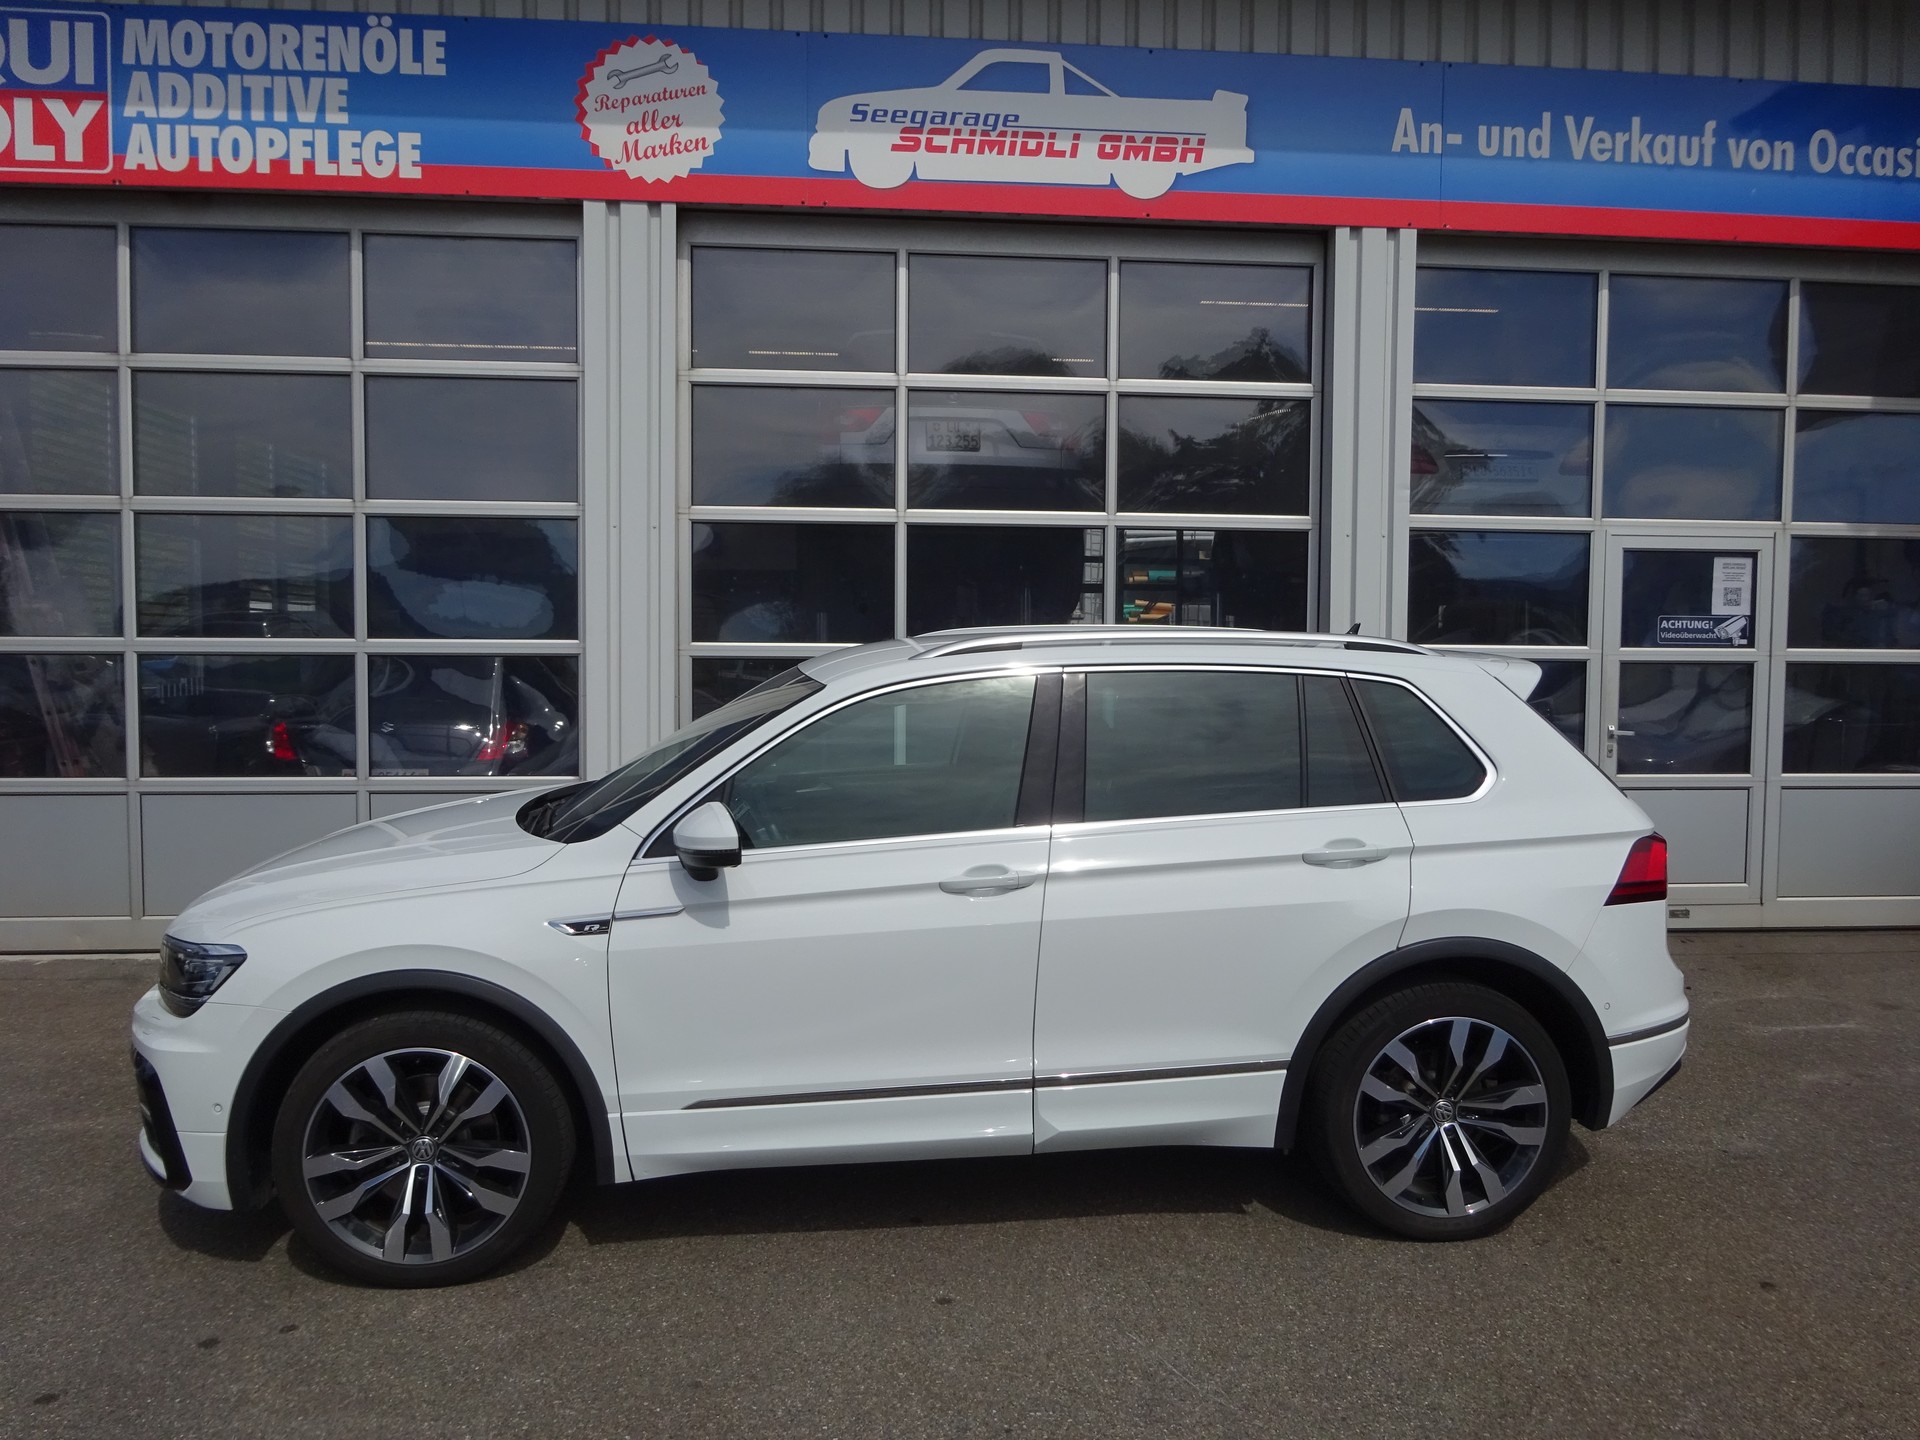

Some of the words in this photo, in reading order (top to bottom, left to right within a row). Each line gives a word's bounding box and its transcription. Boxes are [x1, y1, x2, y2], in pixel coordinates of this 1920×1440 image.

[122, 15, 447, 77] MOTORENÖLE
[123, 71, 349, 125] ADDITIVE
[594, 84, 708, 113] Reparaturen
[0, 97, 104, 162] LY
[626, 108, 684, 135] aller
[849, 103, 1019, 131] Seegarage
[124, 123, 422, 179] AUTOPFLEGE
[614, 133, 709, 165] Marken
[890, 128, 1081, 159] SCHMIDLI
[1097, 134, 1206, 164] GMBH
[1391, 107, 1462, 154] An-
[1478, 111, 1551, 159] und
[1565, 115, 1718, 167] Verkauf
[1728, 137, 1794, 171] von
[1660, 620, 1713, 629] ACHTUNG!
[1660, 631, 1717, 639] Videoüberwacht
